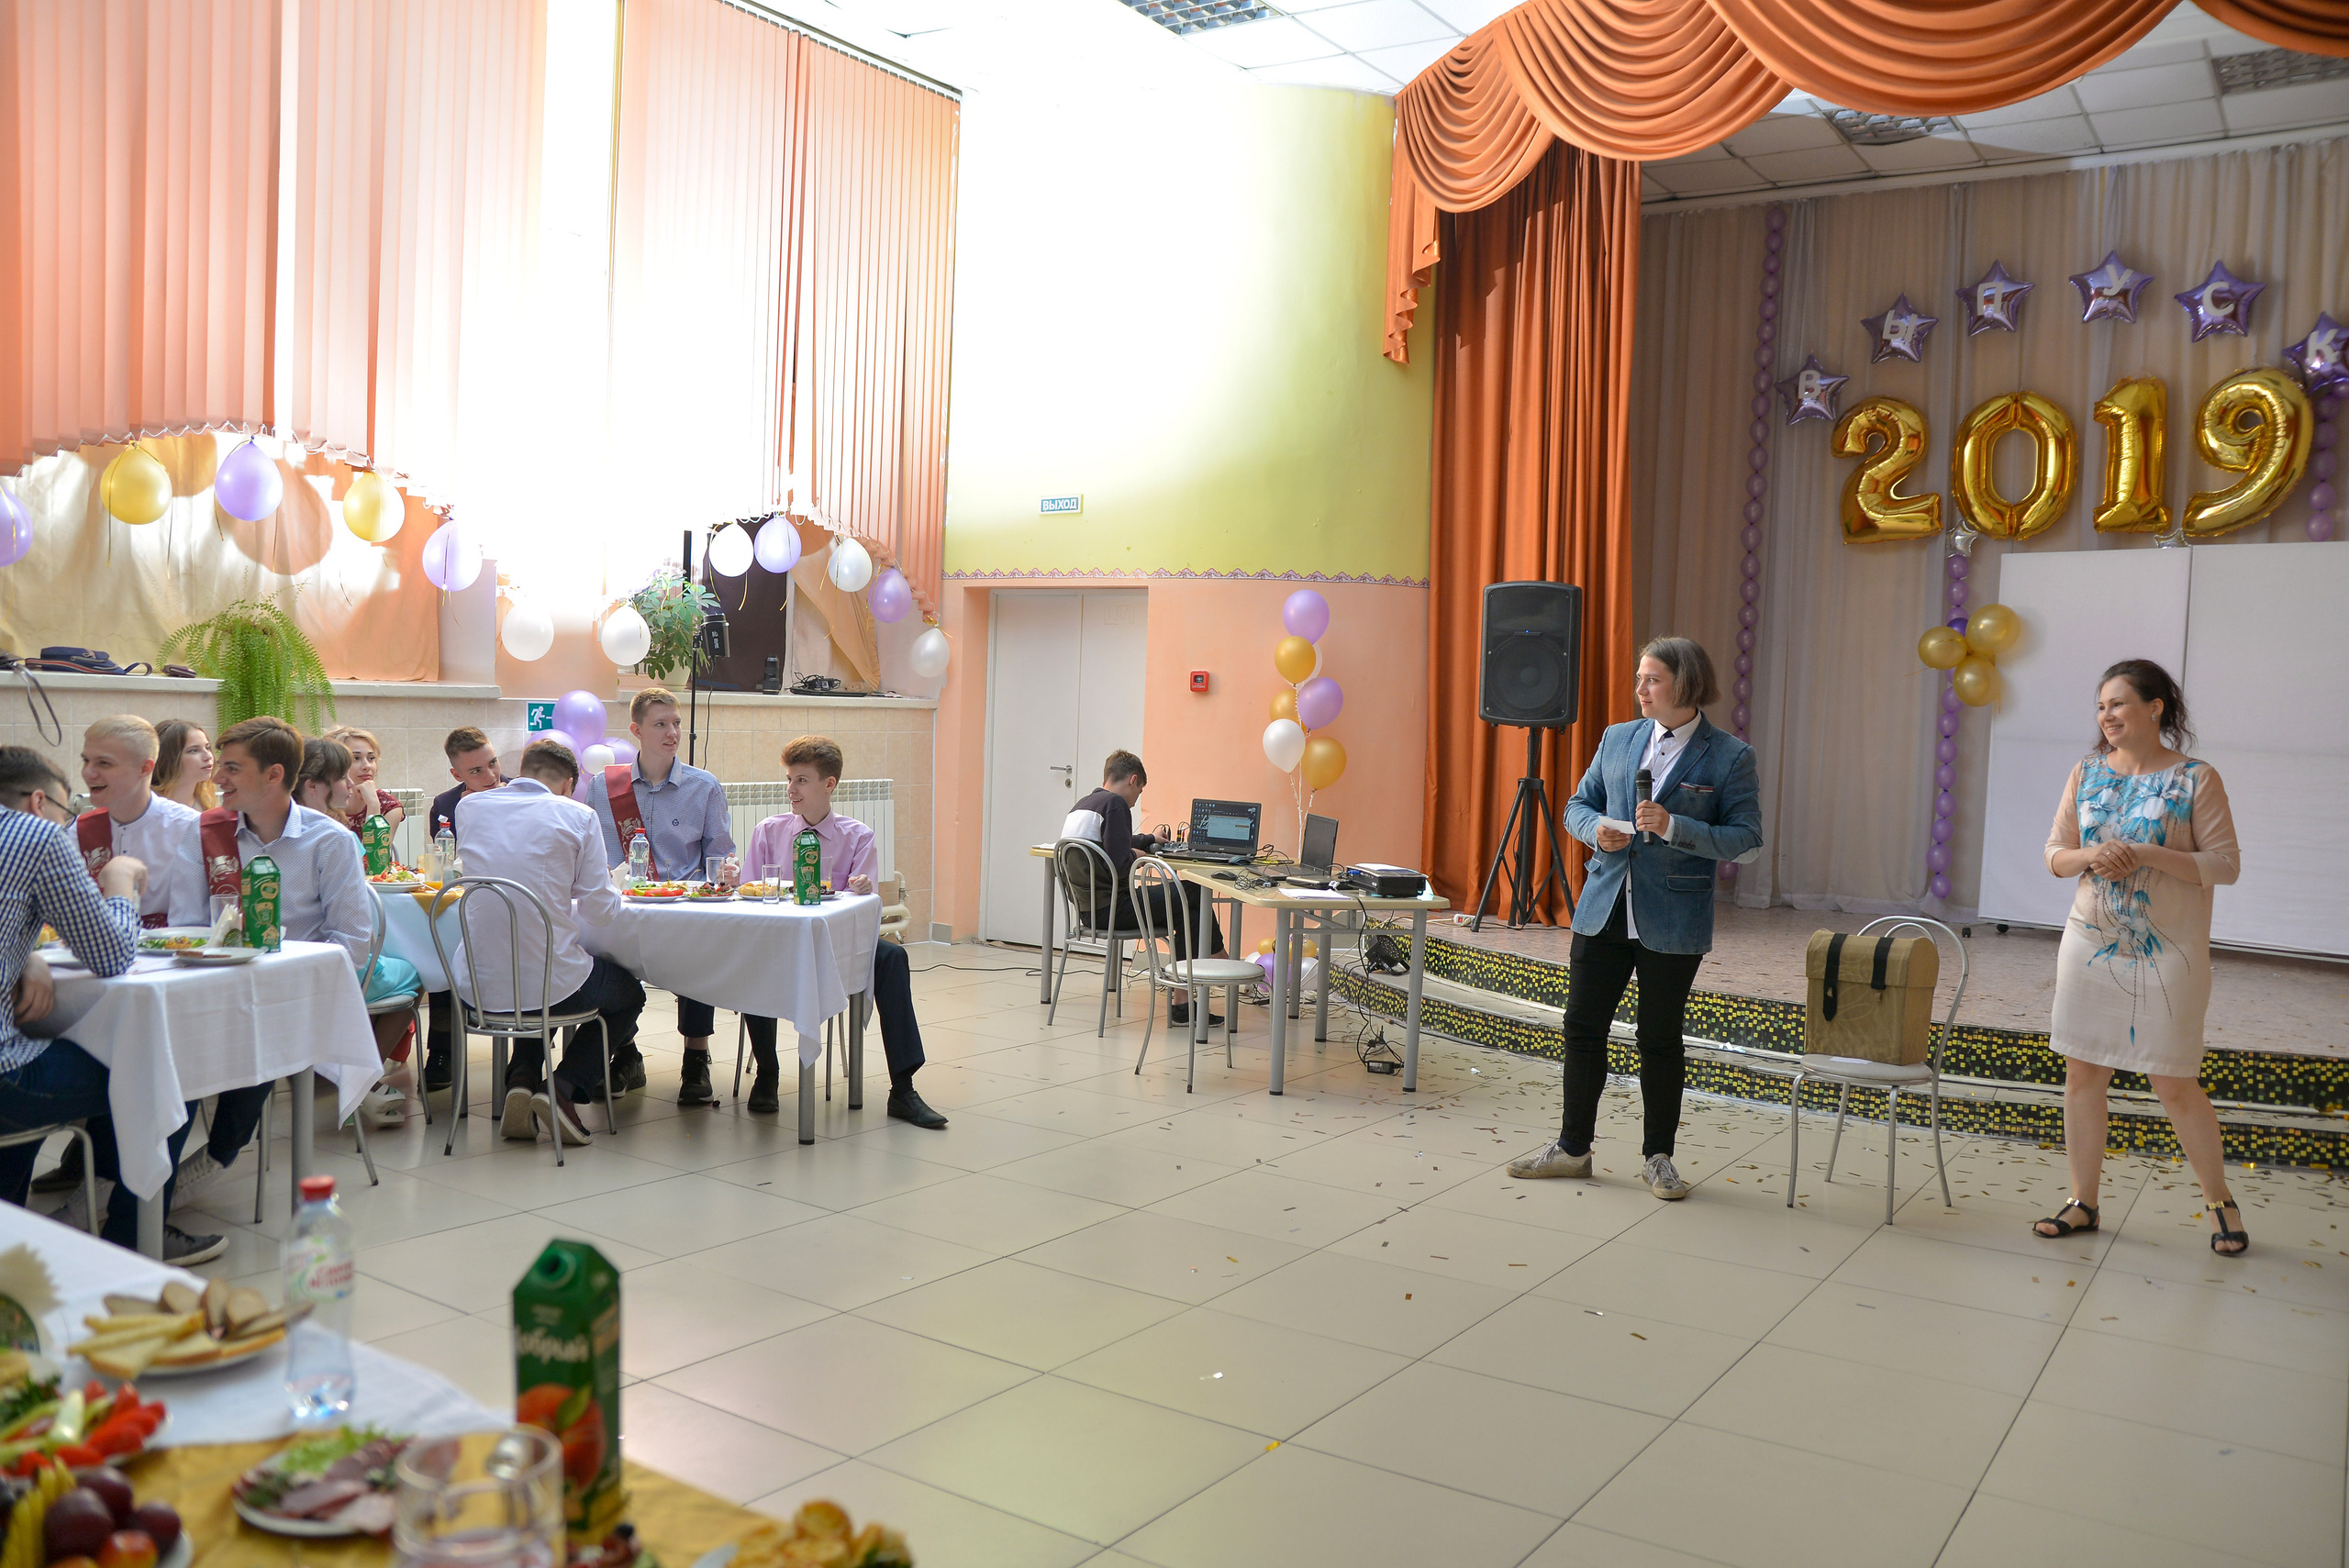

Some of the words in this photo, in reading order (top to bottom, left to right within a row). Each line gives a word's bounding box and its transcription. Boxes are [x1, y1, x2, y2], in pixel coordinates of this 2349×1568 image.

[1798, 264, 2339, 400] ВЫПУСК
[1042, 498, 1077, 511] ВЫХОД
[1831, 367, 2314, 545] 2019
